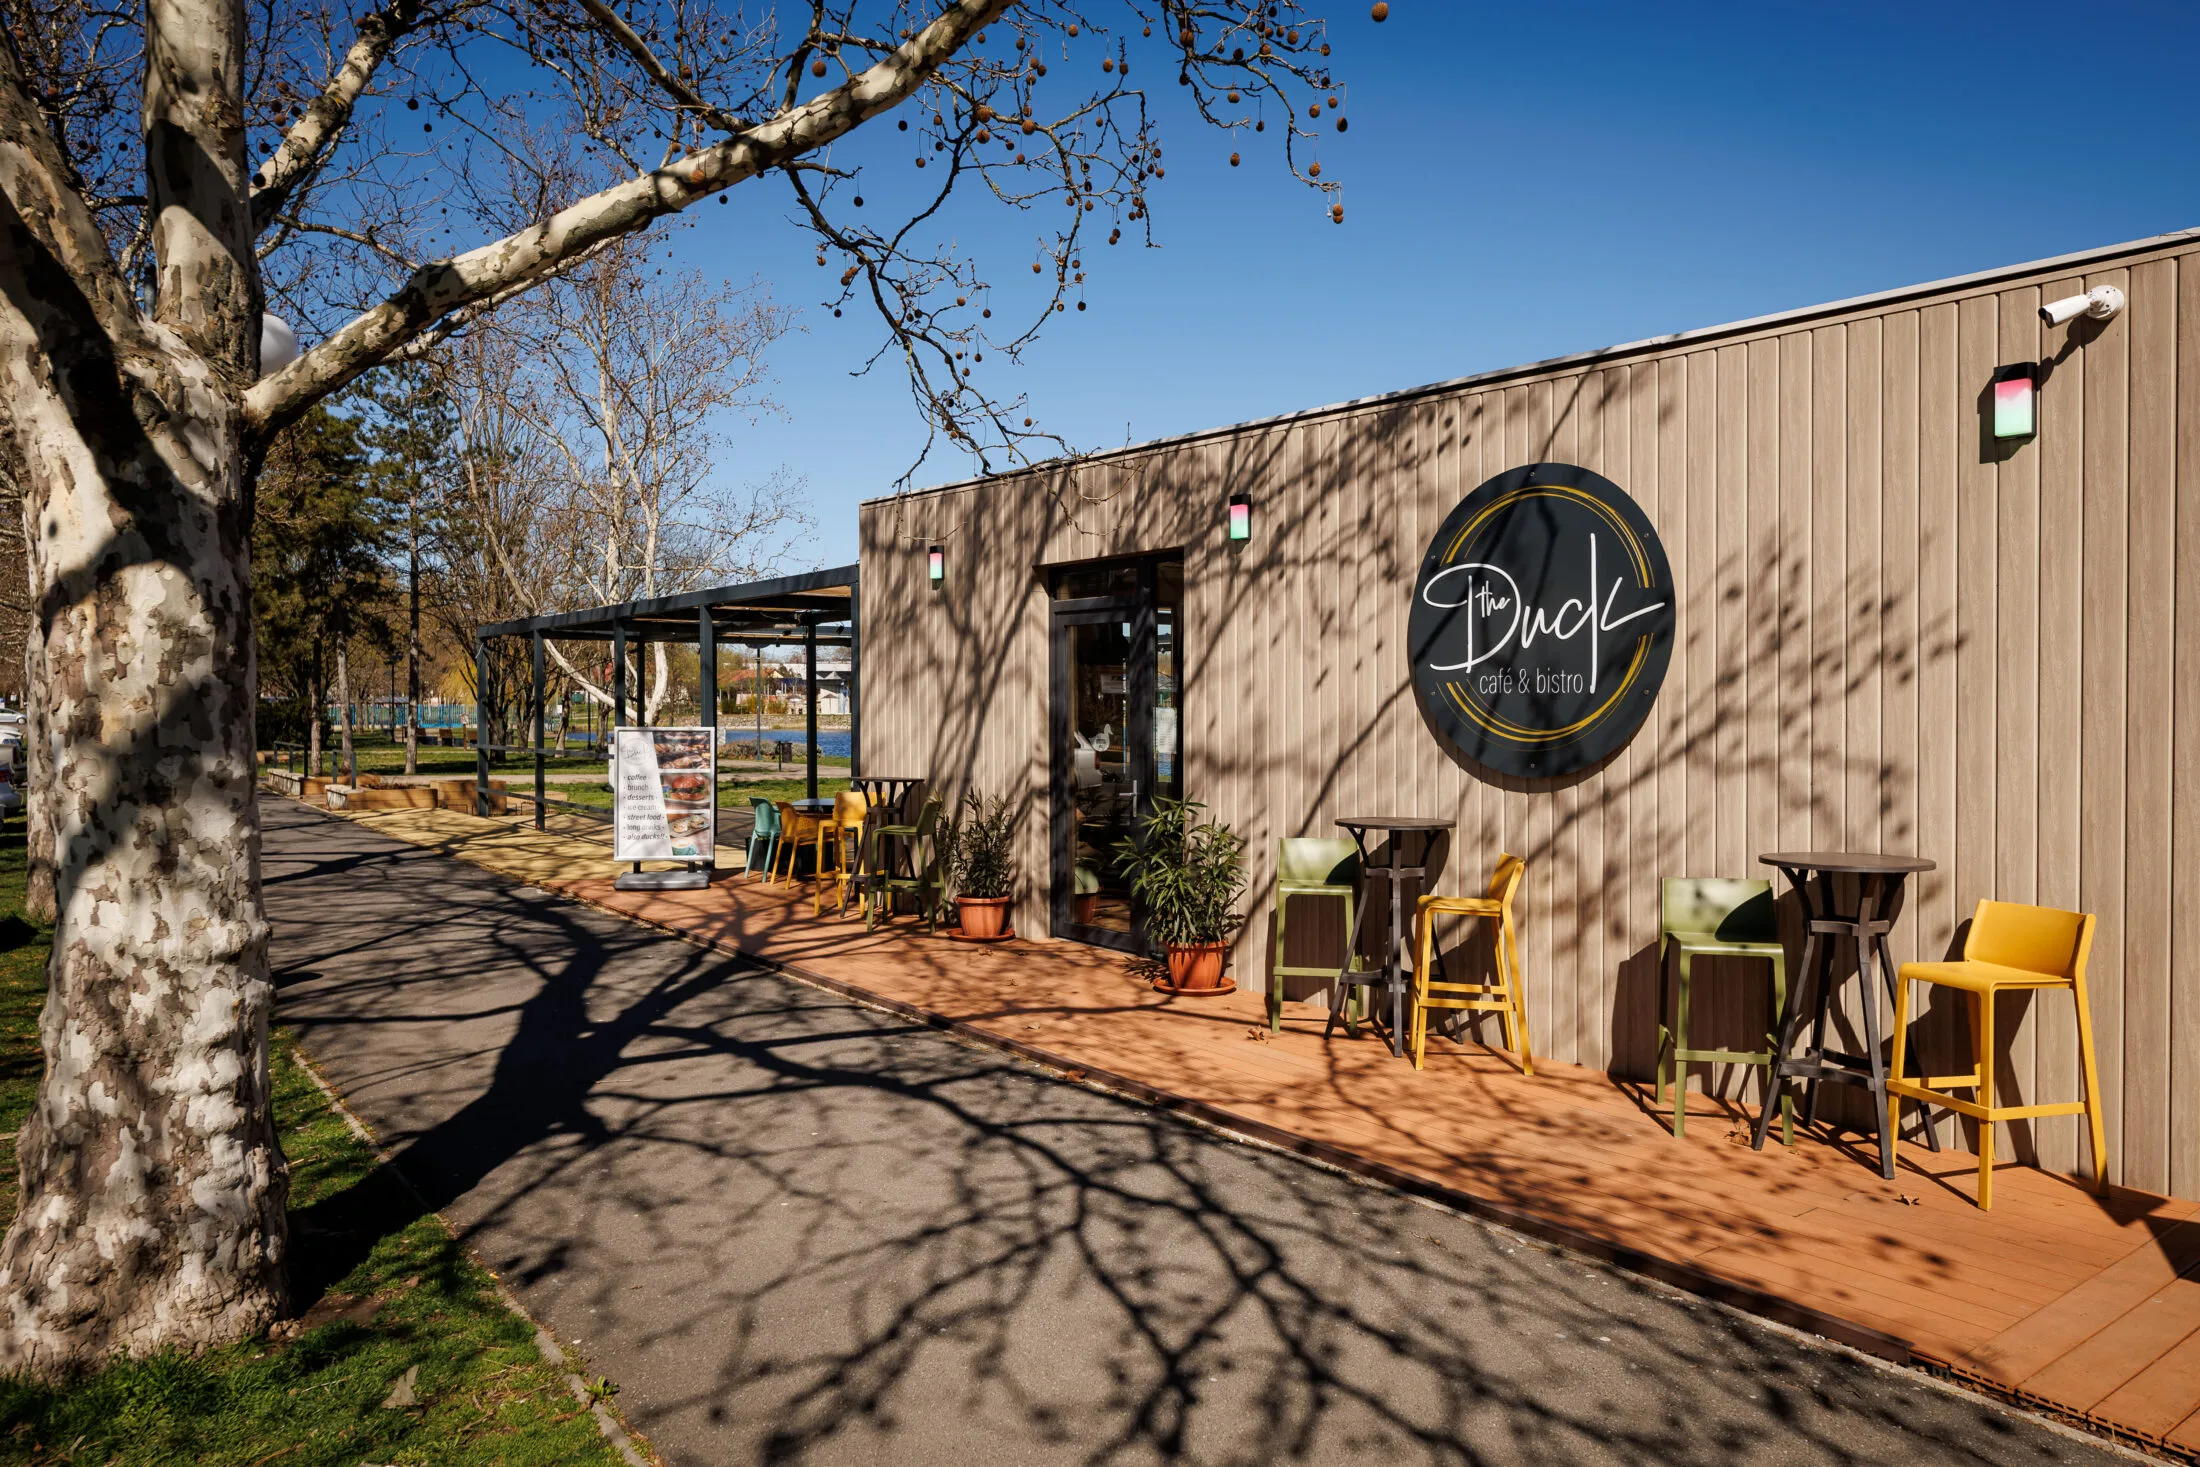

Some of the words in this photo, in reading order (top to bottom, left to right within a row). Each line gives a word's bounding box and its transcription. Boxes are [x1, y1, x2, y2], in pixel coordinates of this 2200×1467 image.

[1475, 580, 1510, 618] the
[1422, 532, 1666, 694] Duck
[1479, 667, 1512, 694] café
[1518, 670, 1530, 694] &
[1536, 668, 1584, 694] bistro
[627, 823, 641, 832] long
[647, 813, 661, 821] food
